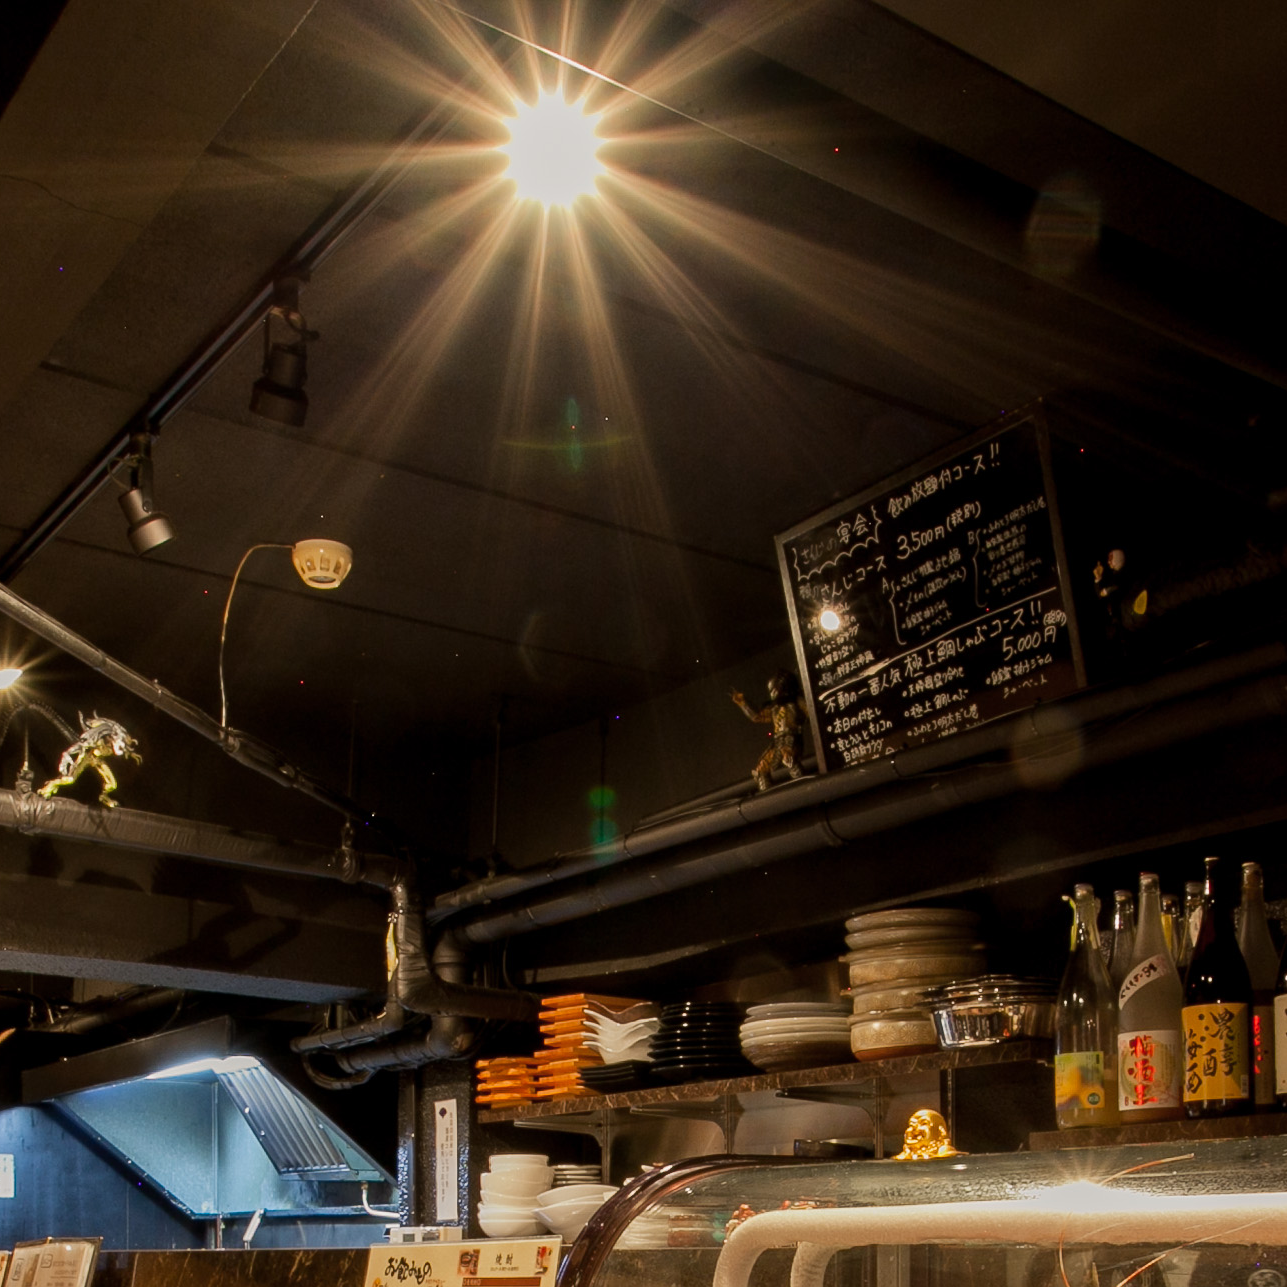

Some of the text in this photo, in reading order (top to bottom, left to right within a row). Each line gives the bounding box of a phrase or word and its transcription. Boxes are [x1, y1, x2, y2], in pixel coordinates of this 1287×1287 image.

[384, 1256, 433, 1285] お飲みもの
